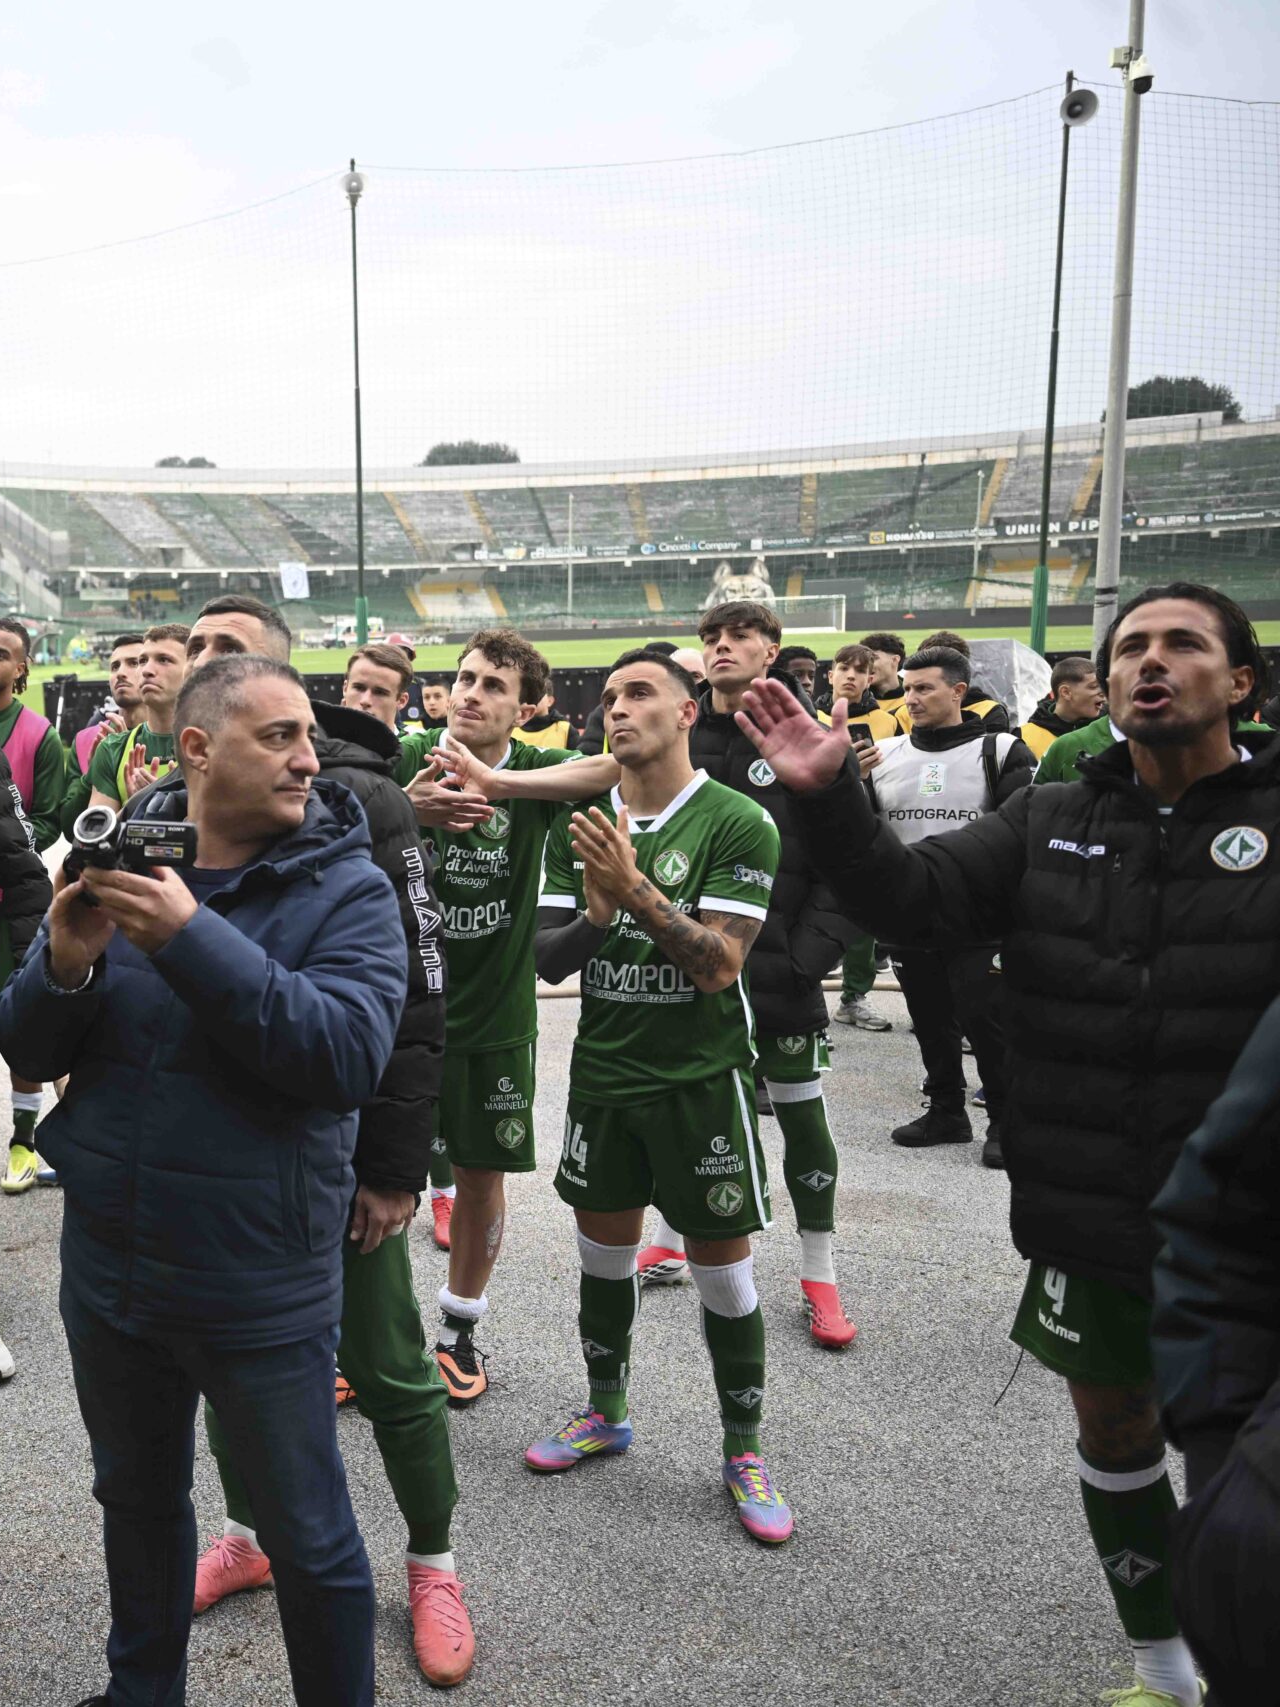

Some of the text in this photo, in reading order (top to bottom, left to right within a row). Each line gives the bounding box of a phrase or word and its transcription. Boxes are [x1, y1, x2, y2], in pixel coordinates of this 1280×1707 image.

[1068, 519, 1100, 532] PIP
[886, 531, 935, 542] KOMATSU
[888, 808, 978, 821] FOTOGRAFO
[125, 838, 144, 846] HD
[445, 859, 460, 872] di
[445, 873, 489, 889] Paesaggi
[438, 899, 511, 931] MOPOL
[586, 957, 695, 994] OSMOPOL
[489, 1092, 522, 1102] GRUPPO
[484, 1099, 528, 1111] MARINELLI
[701, 1154, 738, 1166] GRUPPO
[694, 1160, 744, 1176] MARINELLI
